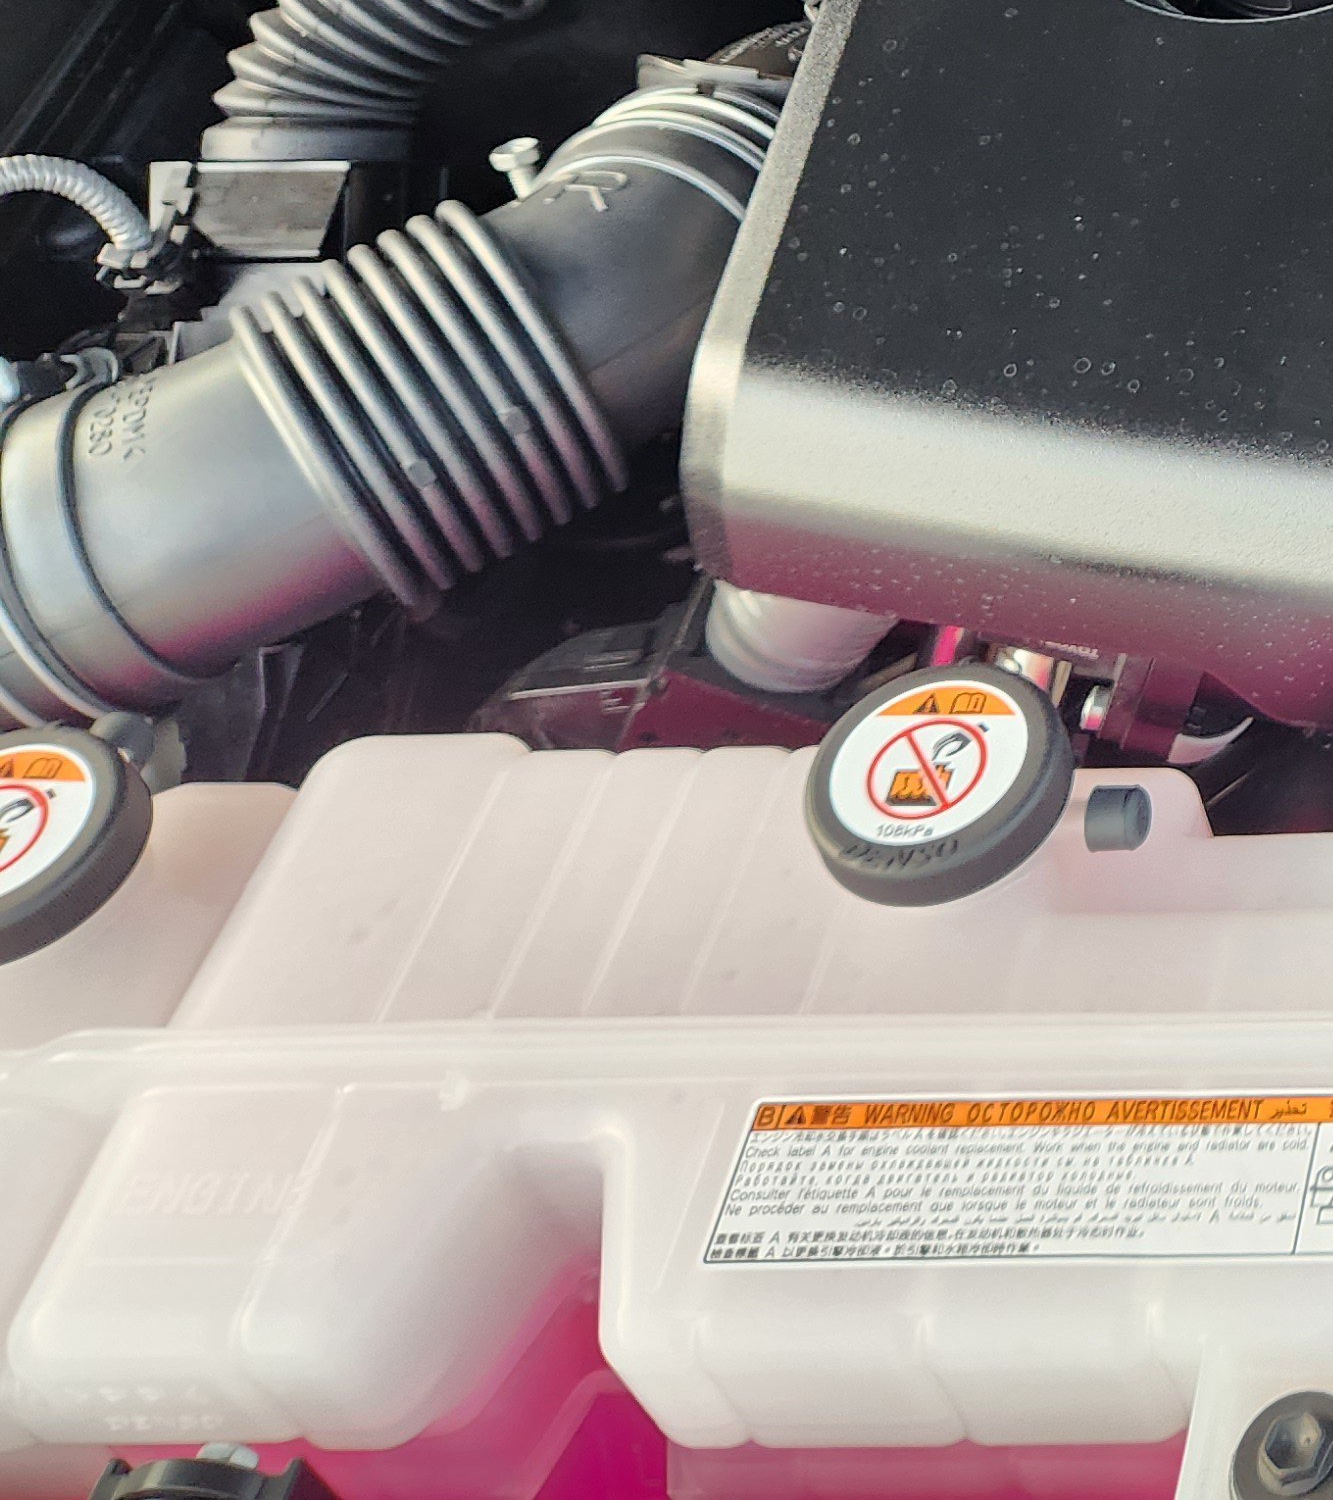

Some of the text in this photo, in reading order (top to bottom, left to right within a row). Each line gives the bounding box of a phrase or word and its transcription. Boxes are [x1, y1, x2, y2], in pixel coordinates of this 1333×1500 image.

[757, 1106, 776, 1127] B
[864, 1103, 954, 1122] WARNING
[1106, 1098, 1264, 1122] AVERTISSEMENT
[745, 1146, 779, 1158] Check
[787, 1146, 815, 1157] label
[821, 1147, 831, 1156] A
[838, 1146, 851, 1156] for
[861, 1144, 899, 1157] engine
[906, 1144, 948, 1155] coolant
[1109, 1141, 1125, 1151] the
[1133, 1141, 1170, 1152] engine
[1177, 1140, 1199, 1151] and
[1206, 1139, 1251, 1151] radiator
[1258, 1141, 1275, 1151] are
[730, 1189, 790, 1200] Consulter
[883, 1188, 914, 1199] pour
[921, 1186, 932, 1198] le
[939, 1184, 1024, 1197] remplacement
[1033, 1185, 1049, 1196] du
[1106, 1183, 1121, 1193] de
[1231, 1181, 1248, 1192] du
[724, 1203, 742, 1216] Ne
[812, 1204, 828, 1214] au
[836, 1200, 922, 1215] remplacement
[930, 1201, 954, 1214] que
[961, 1198, 1007, 1213] lorsque
[1016, 1197, 1027, 1210] le
[1034, 1198, 1077, 1210] moteur
[1085, 1199, 1097, 1209] et
[1105, 1197, 1115, 1209] le
[1123, 1196, 1180, 1209] radiateur
[1188, 1197, 1215, 1208] sont
